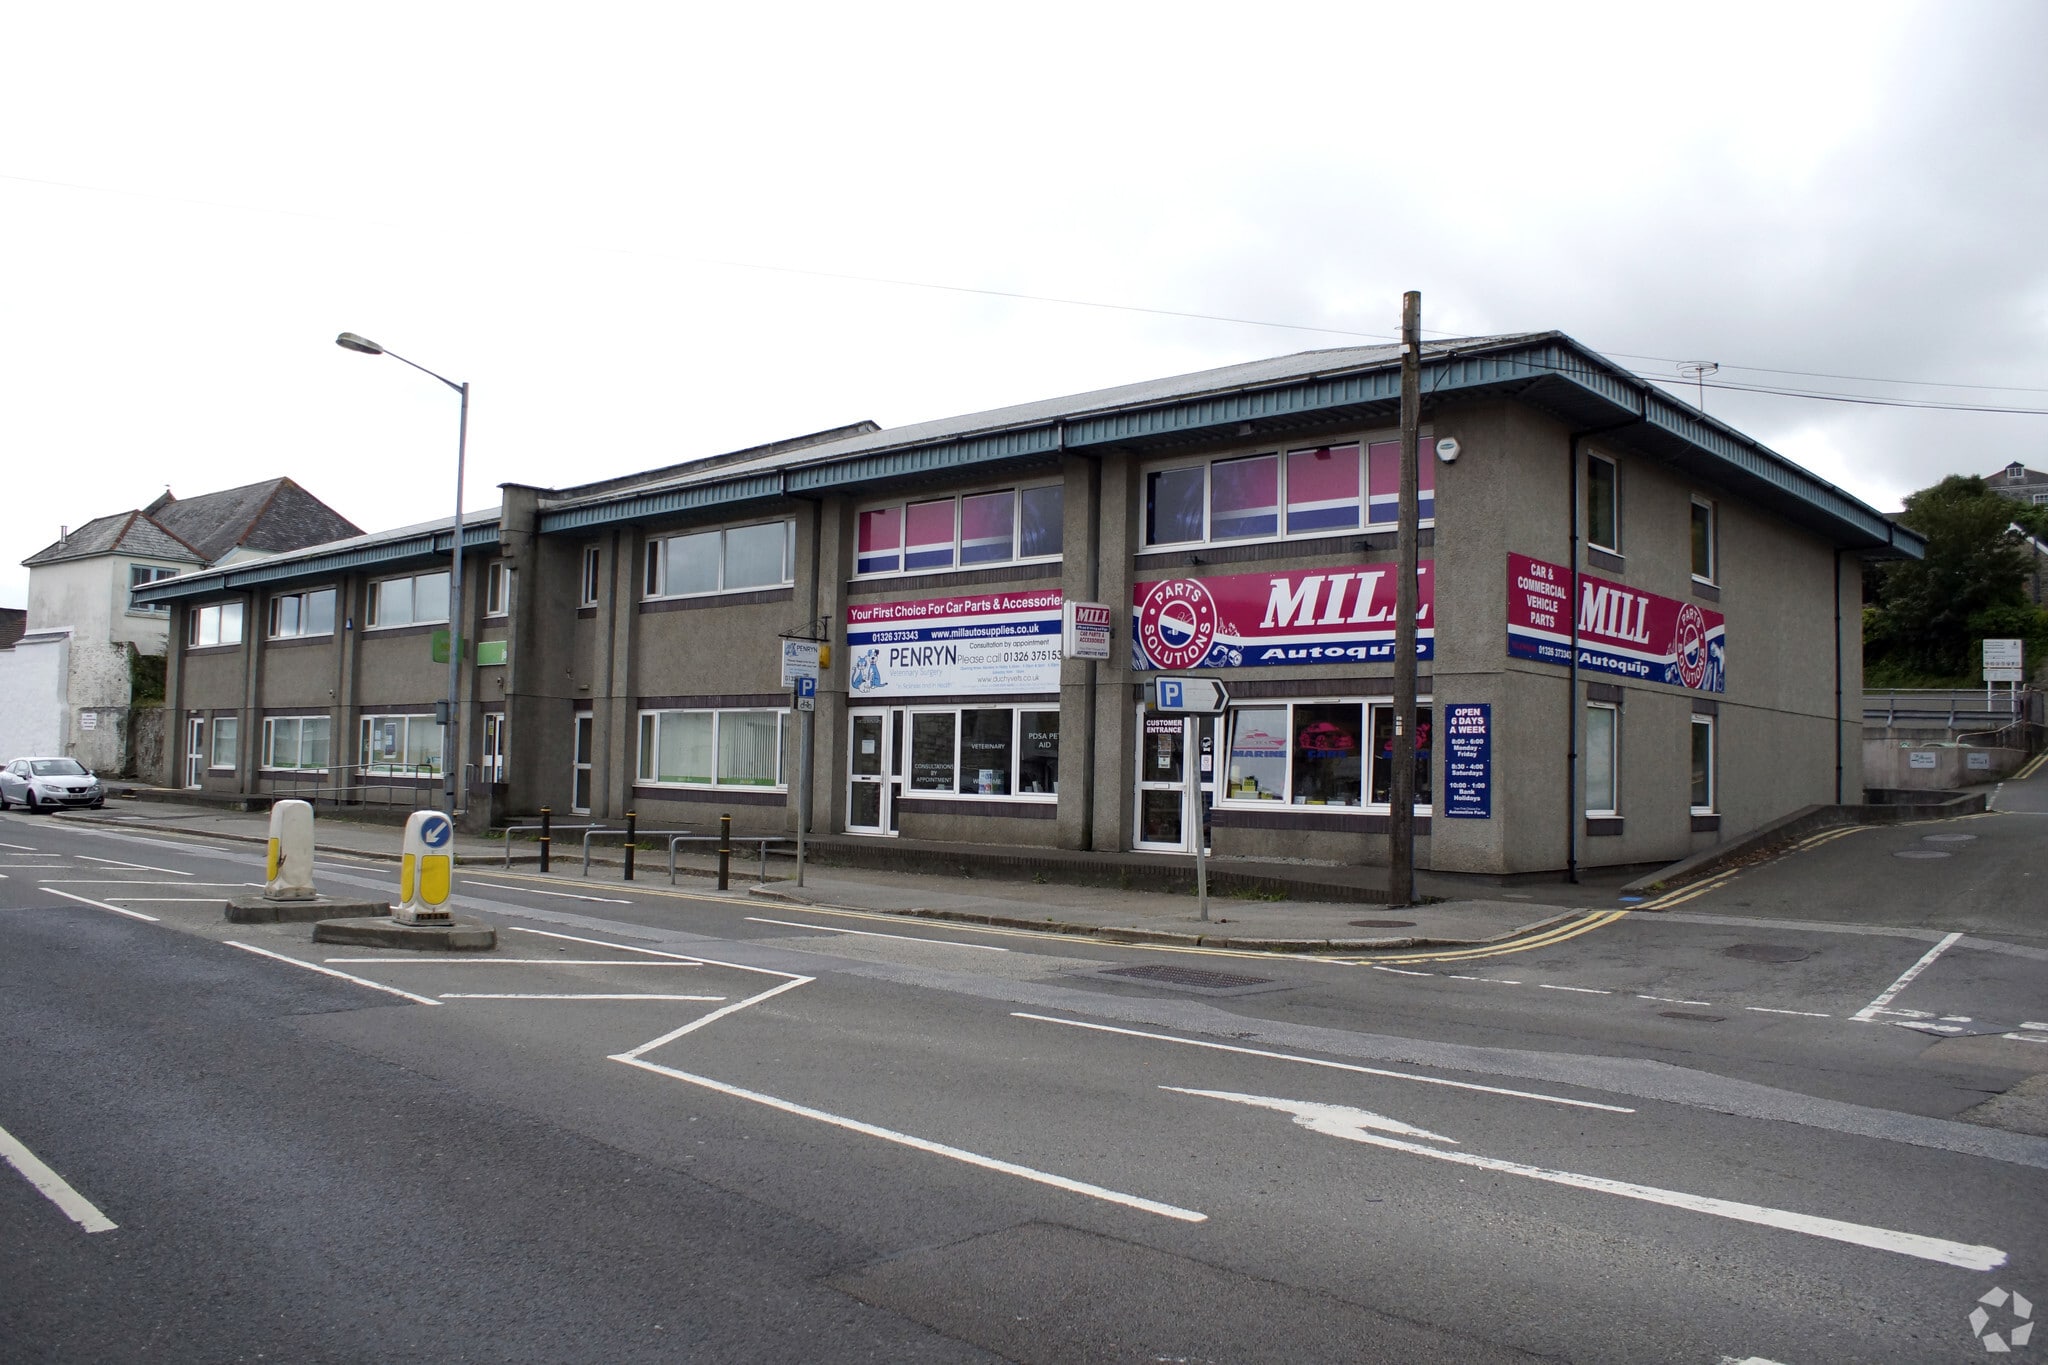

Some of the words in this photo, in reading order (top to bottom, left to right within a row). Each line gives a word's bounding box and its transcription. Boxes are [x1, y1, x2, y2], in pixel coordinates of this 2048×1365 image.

[1531, 564, 1546, 578] CAR
[1548, 568, 1554, 580] &
[1154, 583, 1202, 605] PARTS
[1518, 576, 1566, 600] COMMERCIAL
[851, 609, 872, 620] Your
[873, 607, 894, 618] First
[894, 605, 926, 617] Choice
[928, 604, 944, 614] For
[946, 602, 963, 613] Car
[964, 600, 991, 612] Parts
[993, 598, 1000, 610] &
[1526, 594, 1558, 612] VEHICLE
[1077, 608, 1109, 624] MILL
[1530, 612, 1555, 628] PARTS
[1578, 582, 1650, 644] MILL
[1682, 608, 1700, 628] PARTS
[872, 632, 892, 642] 01326
[894, 630, 918, 640] 373343
[931, 623, 1040, 638] www.millautosupplies.co.uk
[1012, 639, 1050, 648] appointment
[1144, 622, 1211, 665] SOLUTIONS
[1260, 643, 1427, 660] Autoqu
[889, 645, 957, 667] PENRYN
[958, 654, 984, 664] Please
[986, 653, 1002, 663] call
[1004, 652, 1028, 662] 01326
[1032, 650, 1062, 661] 375153
[1579, 652, 1650, 676] Autoquip
[802, 680, 812, 696] P
[1165, 684, 1179, 706] P
[1455, 708, 1480, 716] OPEN
[1450, 726, 1456, 734] A
[1458, 726, 1486, 734] WEEK
[1232, 750, 1286, 758] MARINE
